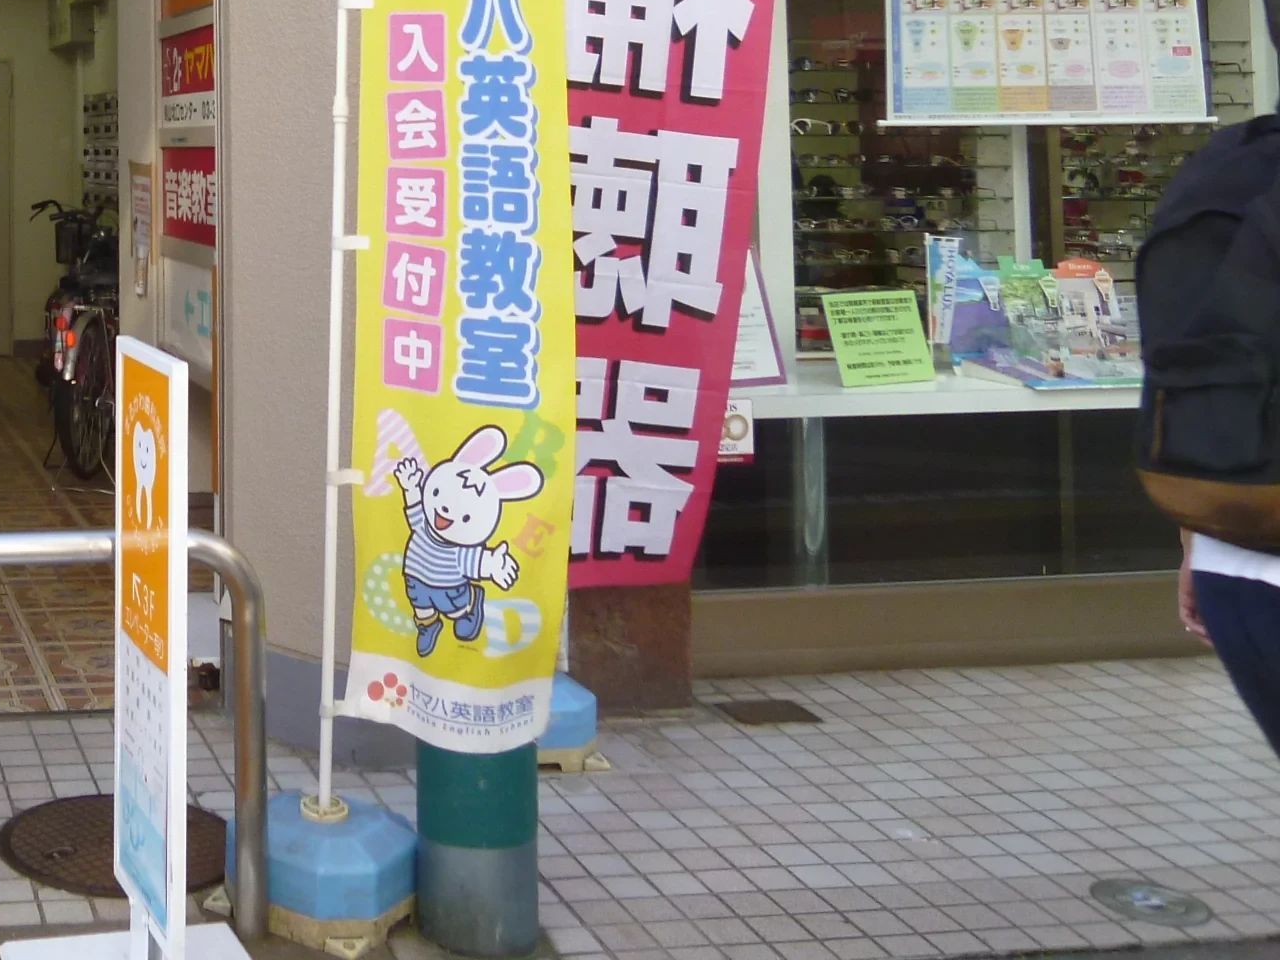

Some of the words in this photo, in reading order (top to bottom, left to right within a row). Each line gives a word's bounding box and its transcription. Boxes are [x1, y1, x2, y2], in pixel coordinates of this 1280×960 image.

[391, 23, 439, 375] 入会受付中
[409, 682, 535, 724] ヤマハ英語教室
